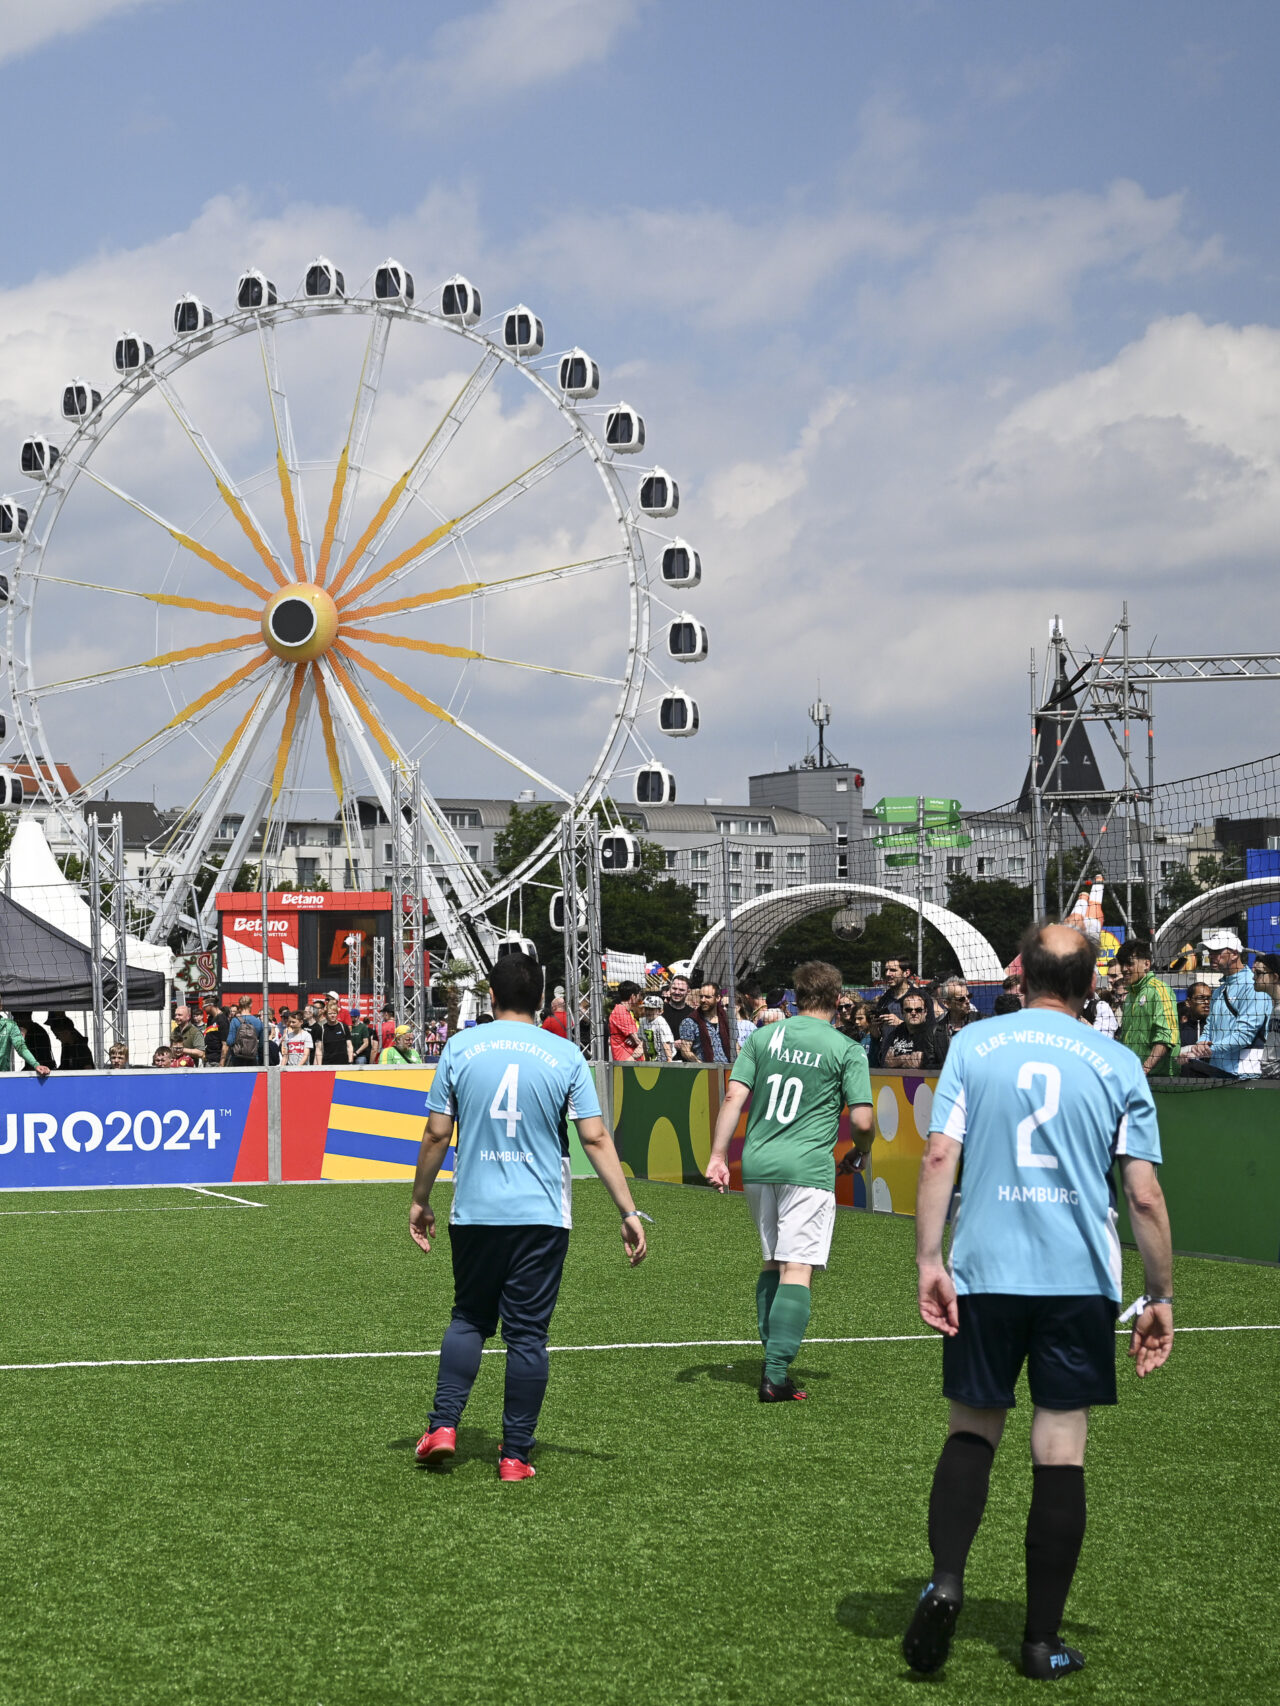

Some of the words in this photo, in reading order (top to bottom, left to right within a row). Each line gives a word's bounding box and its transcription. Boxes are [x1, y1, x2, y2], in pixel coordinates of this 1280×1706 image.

[281, 893, 325, 905] Betano
[464, 1039, 559, 1069] ELBE-WERKSTÄTTEN
[767, 1024, 822, 1068] MARLI
[974, 1029, 1113, 1077] ELBE-WERKSTÄTTEN
[489, 1063, 522, 1138] 4
[764, 1073, 804, 1125] 10
[1016, 1061, 1061, 1169] 2
[480, 1150, 535, 1163] HAMBURG
[998, 1185, 1079, 1206] HAMBURG
[1049, 1653, 1071, 1669] FILA
